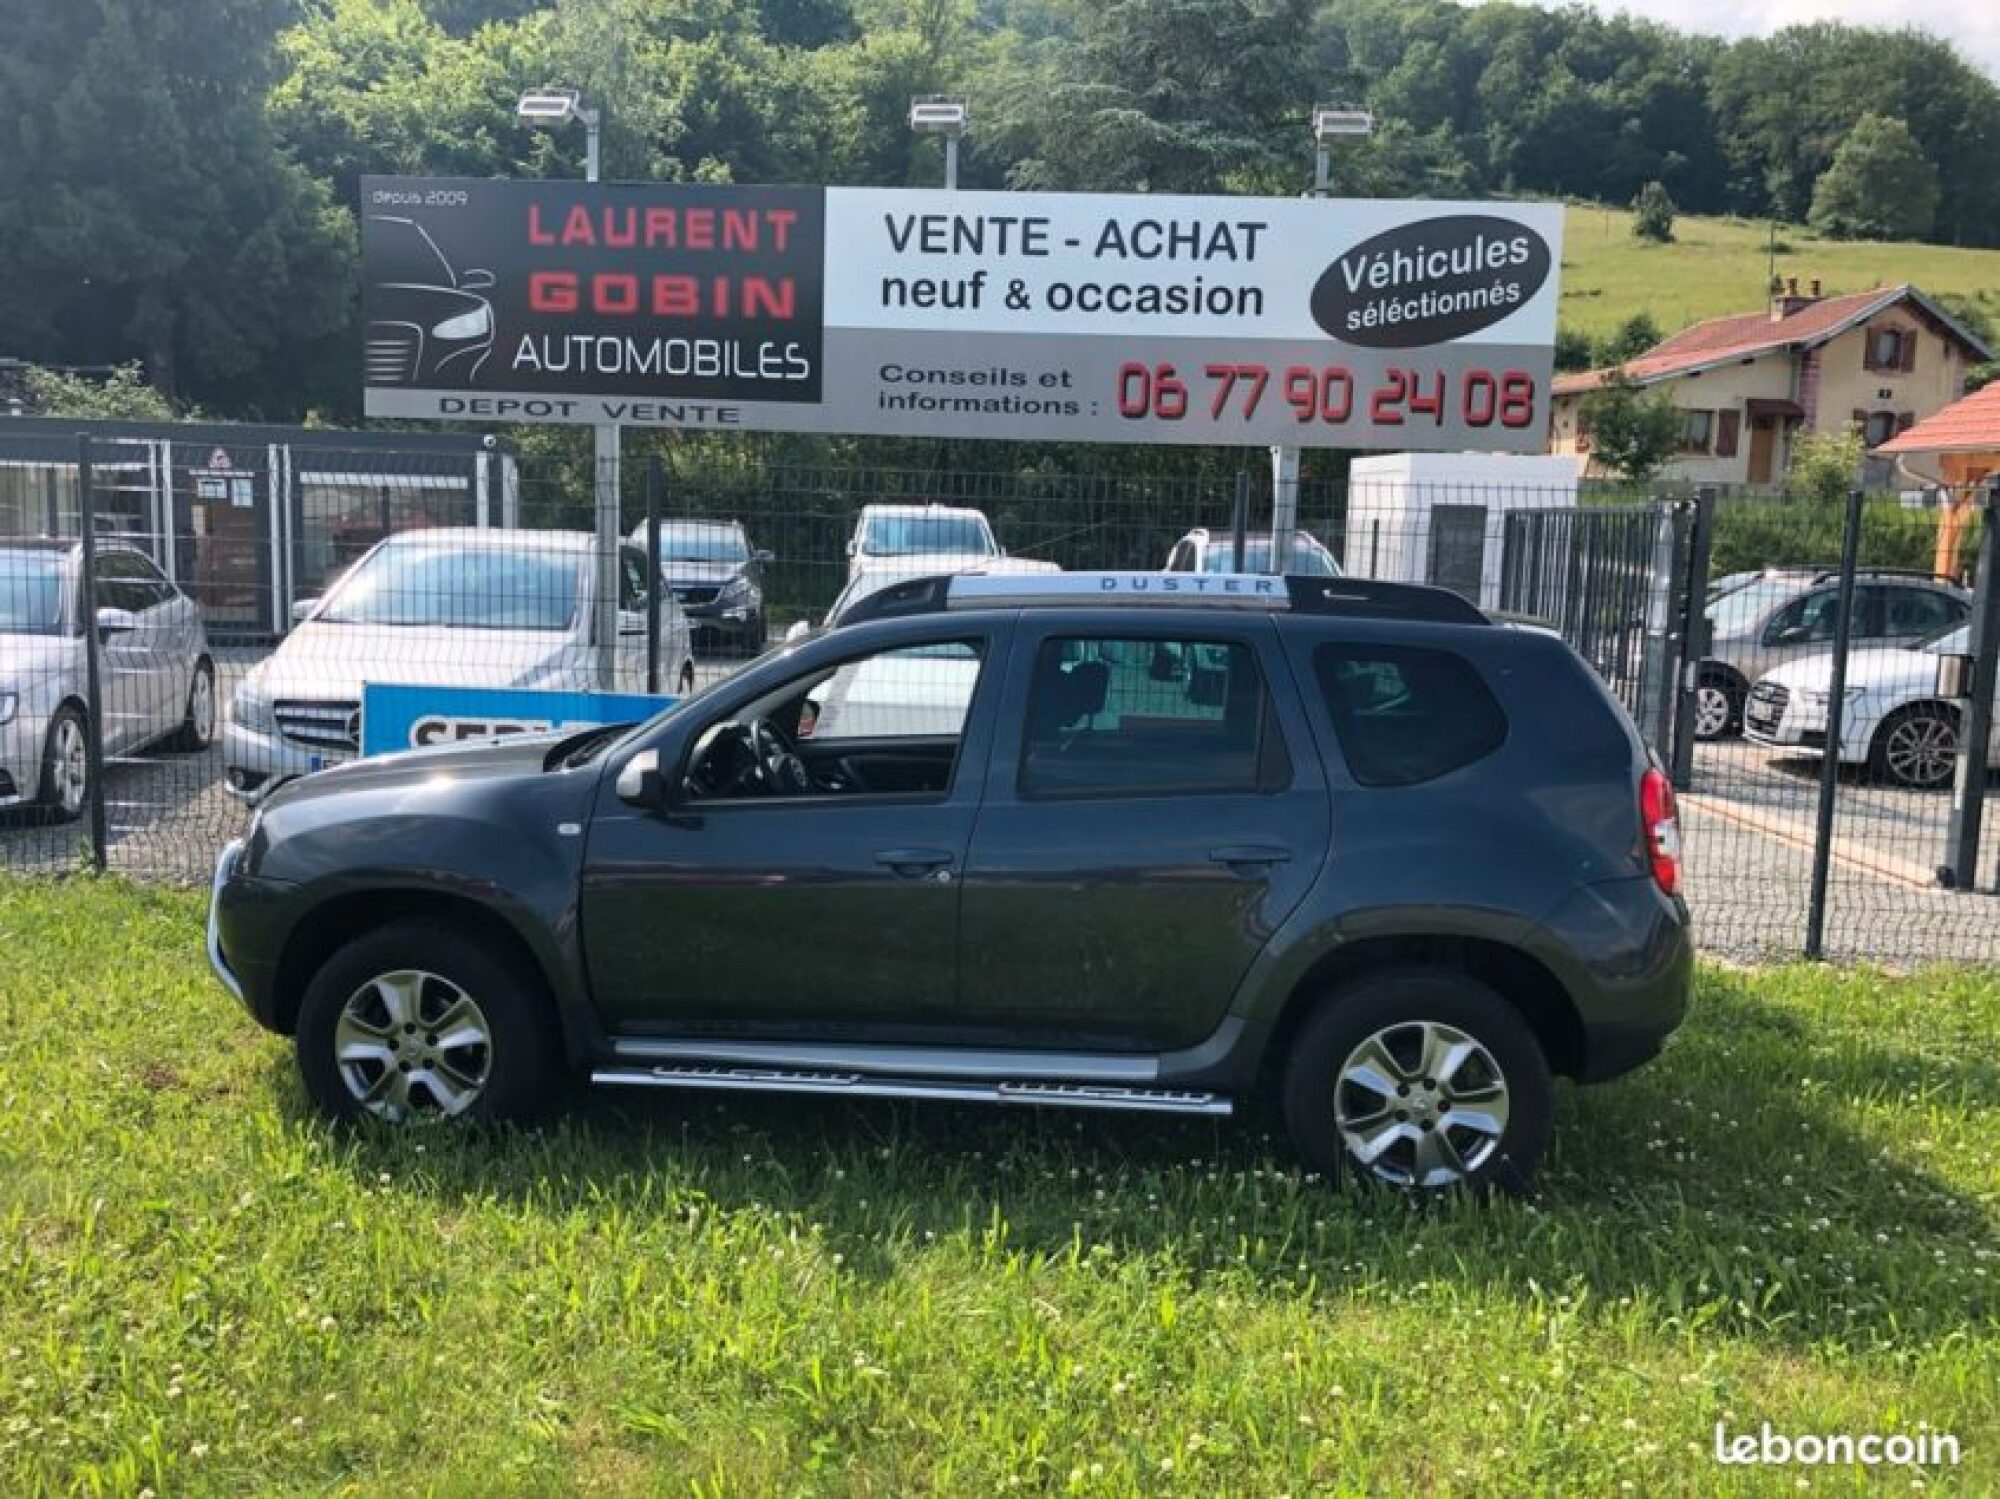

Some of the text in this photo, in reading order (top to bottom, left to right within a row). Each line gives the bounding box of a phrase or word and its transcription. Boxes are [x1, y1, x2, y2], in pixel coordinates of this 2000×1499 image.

[425, 190, 468, 206] 2009
[528, 203, 797, 251] LAURENT
[884, 214, 1051, 256] VENTE
[1094, 218, 1267, 262] ACHAT
[1340, 233, 1530, 294] Véhicules
[528, 270, 796, 319] GOBIN
[882, 270, 1265, 317] neuf & occasion
[1347, 277, 1521, 331] séléctionnés
[512, 333, 810, 381] AUTOMOBILES
[879, 364, 1073, 389] Conseils et
[439, 397, 741, 424] DEPOT VENTE
[879, 391, 1080, 416] informations
[1117, 361, 1536, 429] 06 77 90 24 08
[1102, 577, 1274, 594] DUSTER
